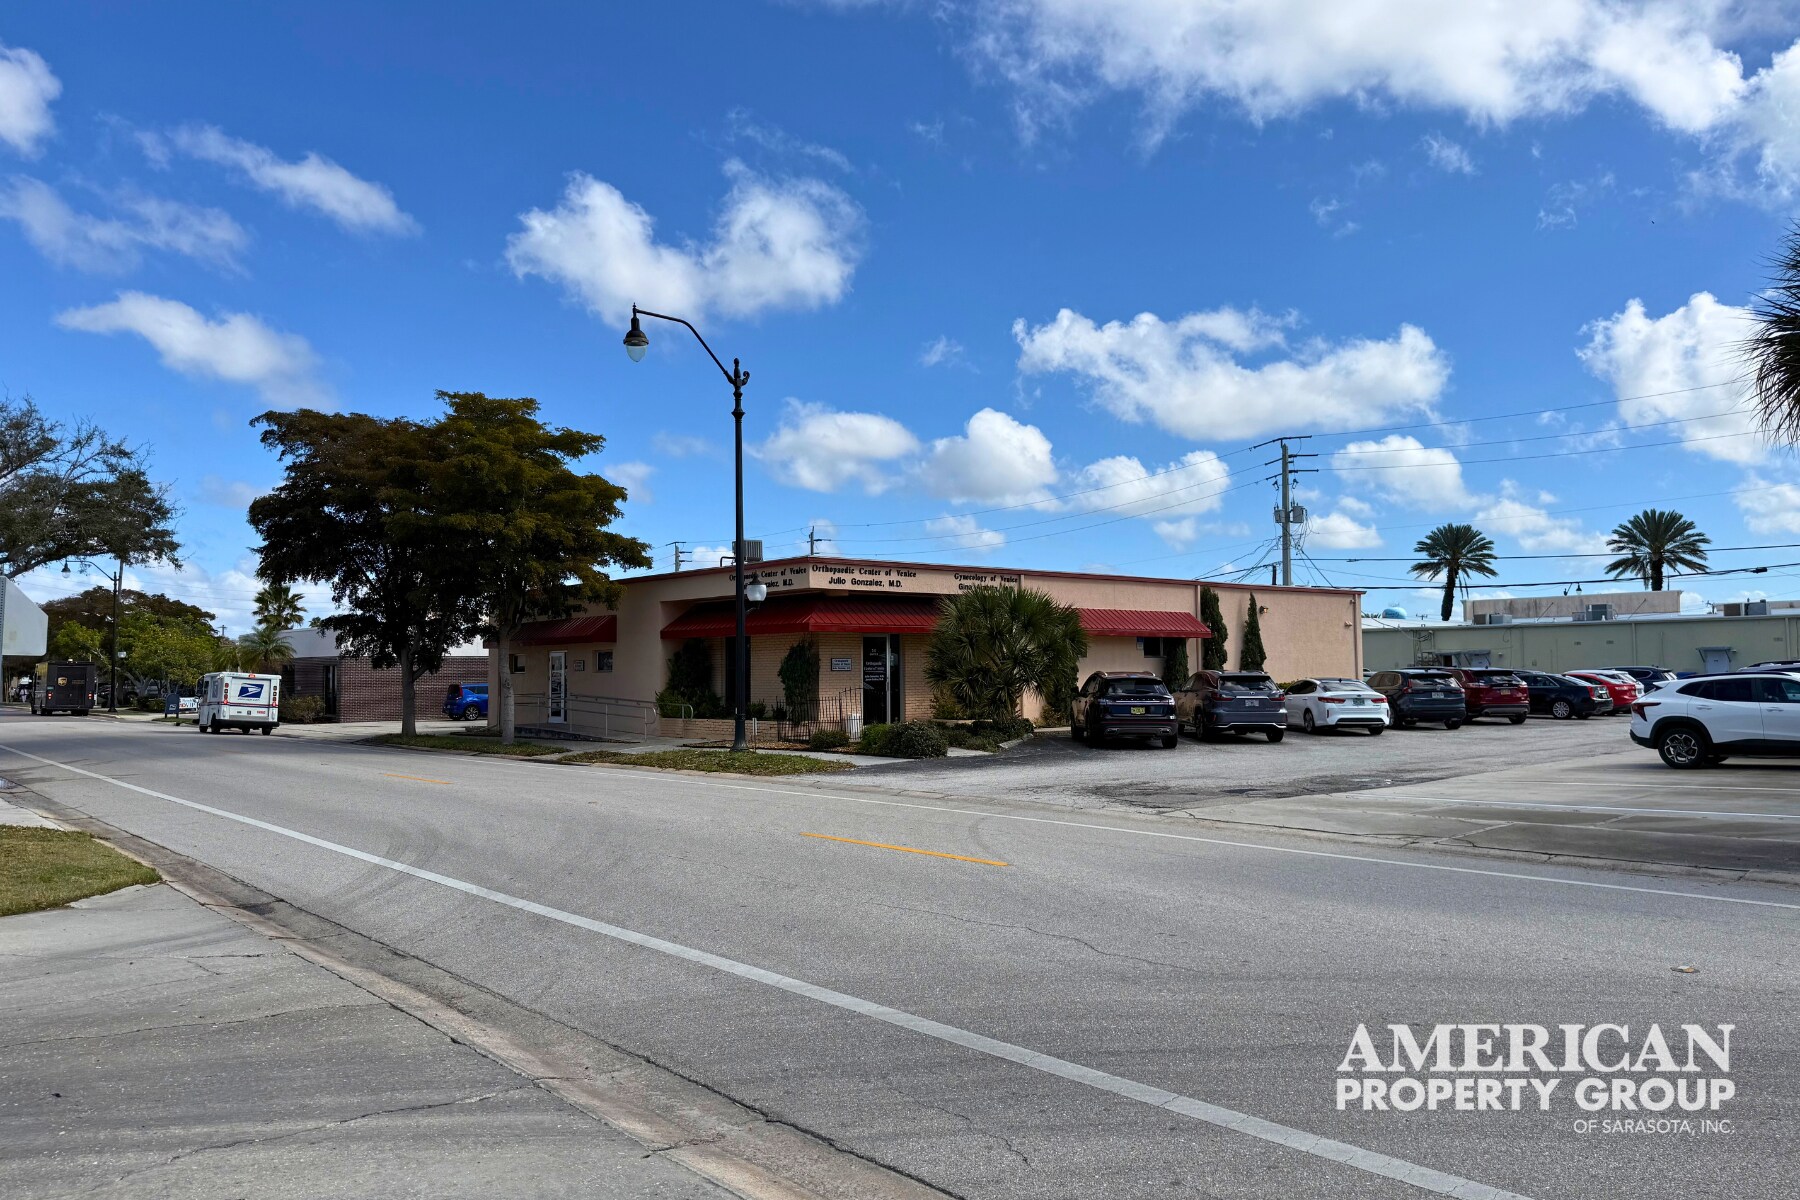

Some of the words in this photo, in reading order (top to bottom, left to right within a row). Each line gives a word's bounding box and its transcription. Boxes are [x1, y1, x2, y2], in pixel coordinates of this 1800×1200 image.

[761, 570, 778, 578] Center
[780, 568, 787, 576] of
[789, 567, 807, 575] Venice
[811, 564, 855, 575] Orthopaedic
[859, 567, 881, 576] Center
[896, 570, 917, 578] Venice
[782, 578, 794, 586] M.D.
[828, 577, 846, 585] Julio
[851, 578, 885, 587] Gonzalez,
[888, 580, 903, 588] M.D.
[954, 572, 987, 582] Gynecology
[1000, 575, 1018, 583] Venice
